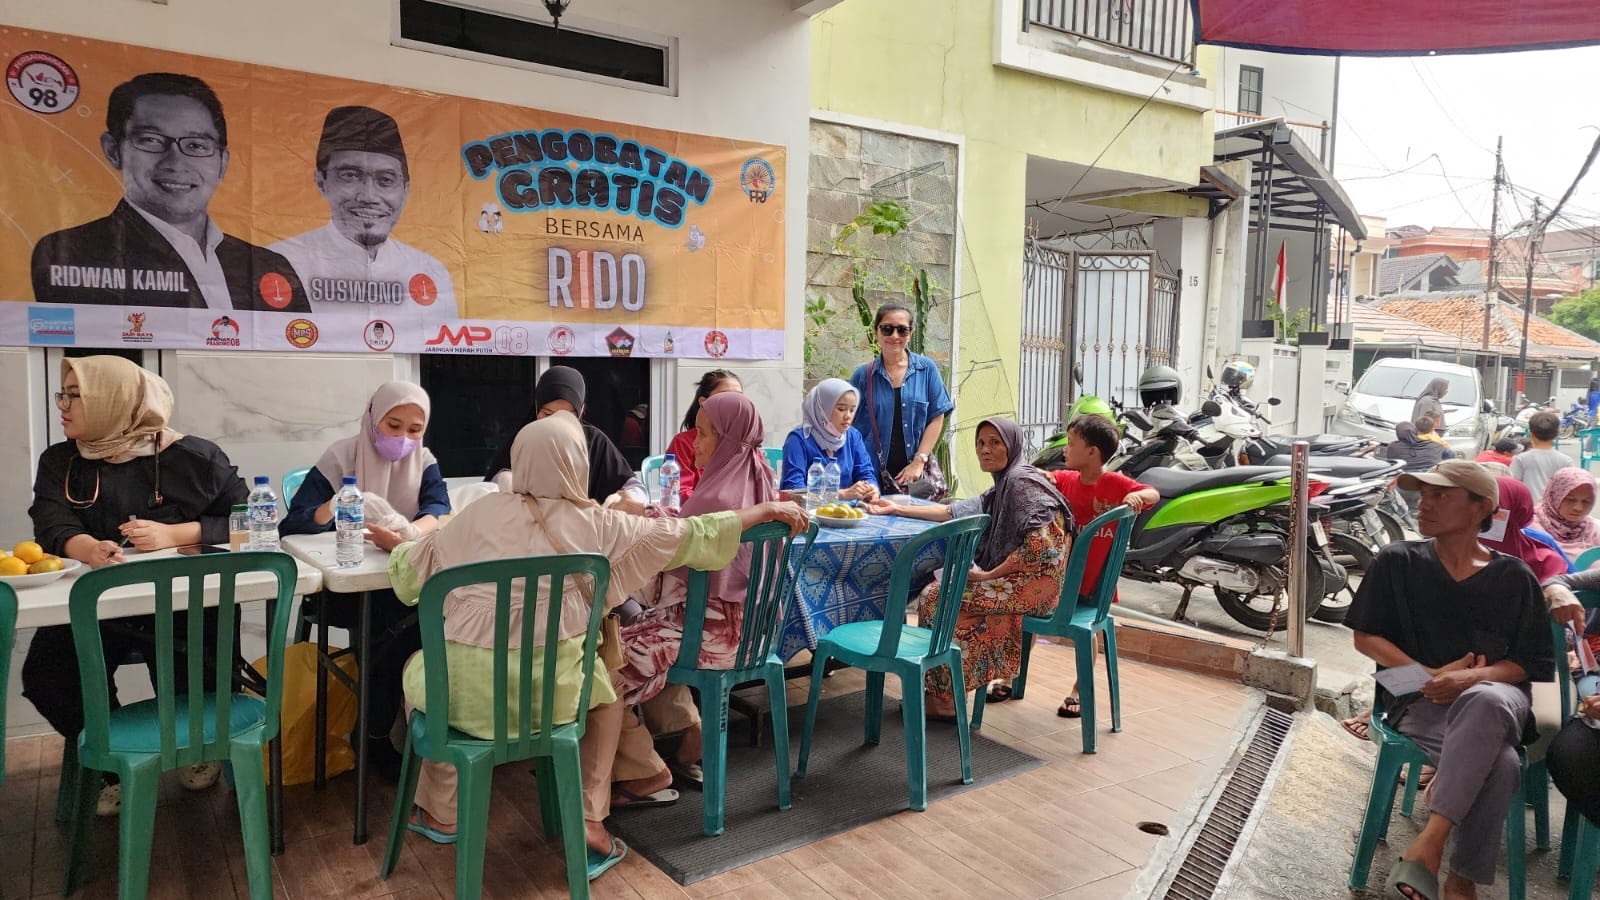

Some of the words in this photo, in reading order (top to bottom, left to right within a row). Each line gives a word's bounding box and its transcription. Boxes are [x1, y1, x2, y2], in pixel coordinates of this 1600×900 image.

[29, 88, 58, 108] 98
[462, 131, 712, 203] PENGOBATAN
[499, 166, 686, 226] GRATIS
[546, 217, 644, 242] BERSAMA
[51, 265, 126, 290] RIDWAN
[132, 269, 189, 293] KAMIL
[311, 278, 403, 305] SUSWONO
[293, 328, 312, 339] MPS
[494, 325, 529, 355] 08
